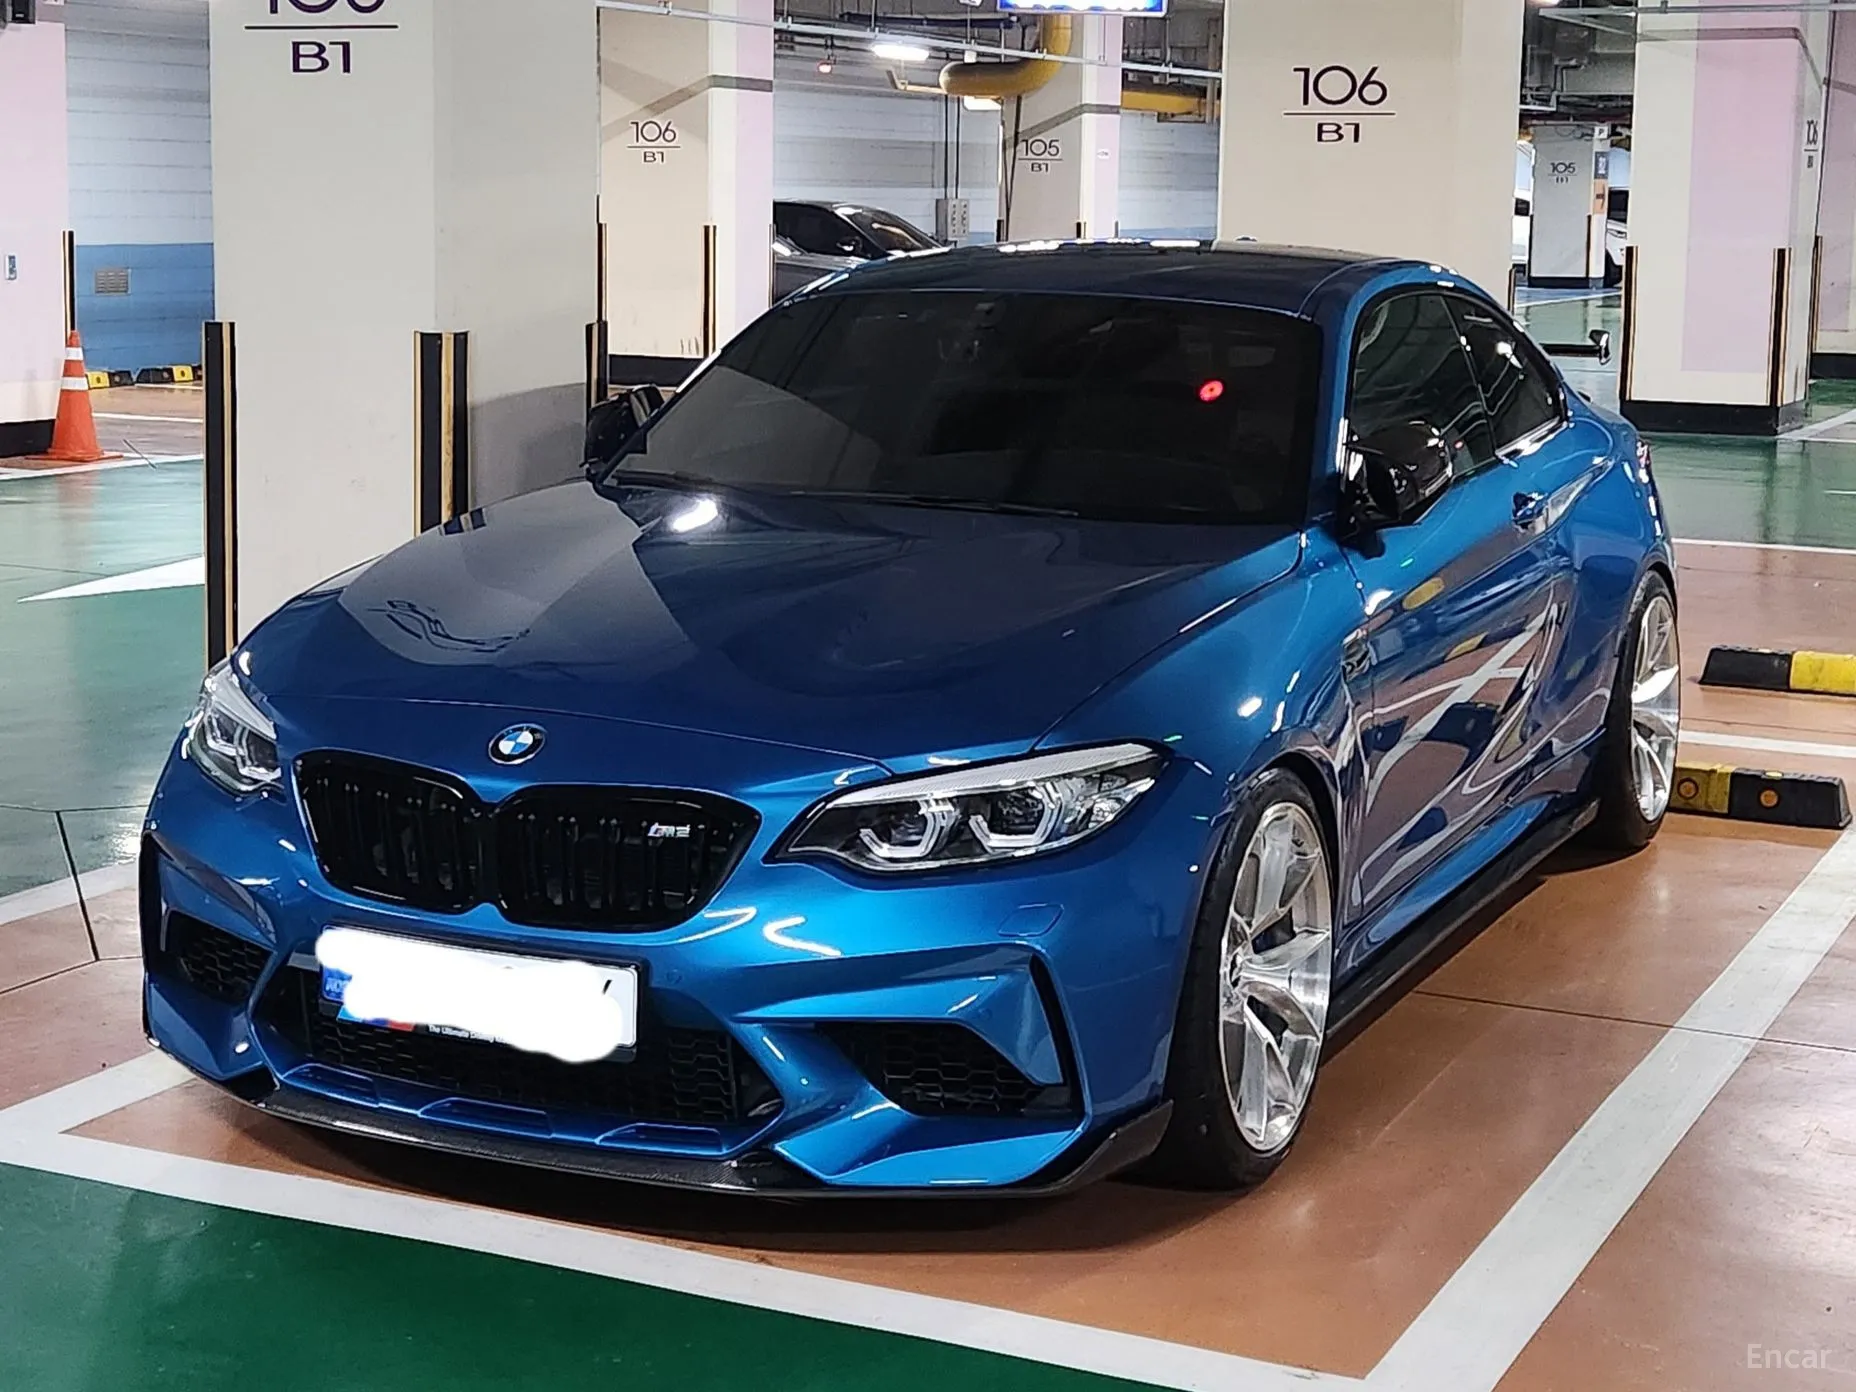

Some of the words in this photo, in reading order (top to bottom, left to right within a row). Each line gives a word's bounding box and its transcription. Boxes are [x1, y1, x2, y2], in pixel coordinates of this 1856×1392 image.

[291, 40, 351, 74] B1
[1292, 65, 1388, 106] 106
[630, 120, 677, 143] 106
[1316, 122, 1361, 143] B1
[643, 150, 665, 163] B1
[1020, 138, 1060, 156] 105
[1030, 162, 1049, 172] B1
[1550, 161, 1576, 174] 105
